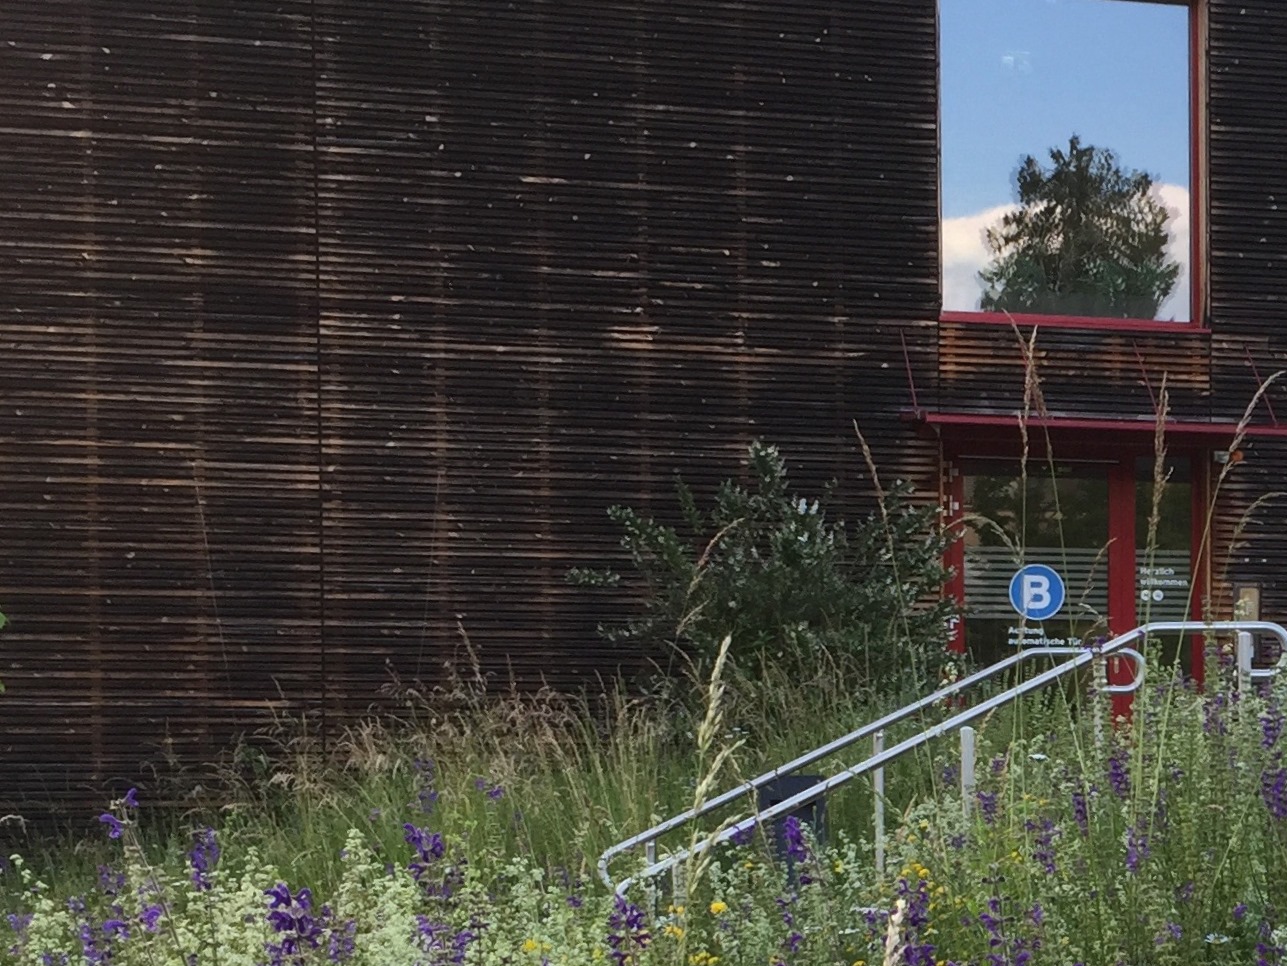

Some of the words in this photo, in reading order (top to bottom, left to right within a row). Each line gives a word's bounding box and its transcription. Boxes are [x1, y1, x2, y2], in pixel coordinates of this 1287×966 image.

[1023, 575, 1051, 609] B
[1008, 626, 1044, 636] Actung
[1008, 637, 1065, 646] auomatische
